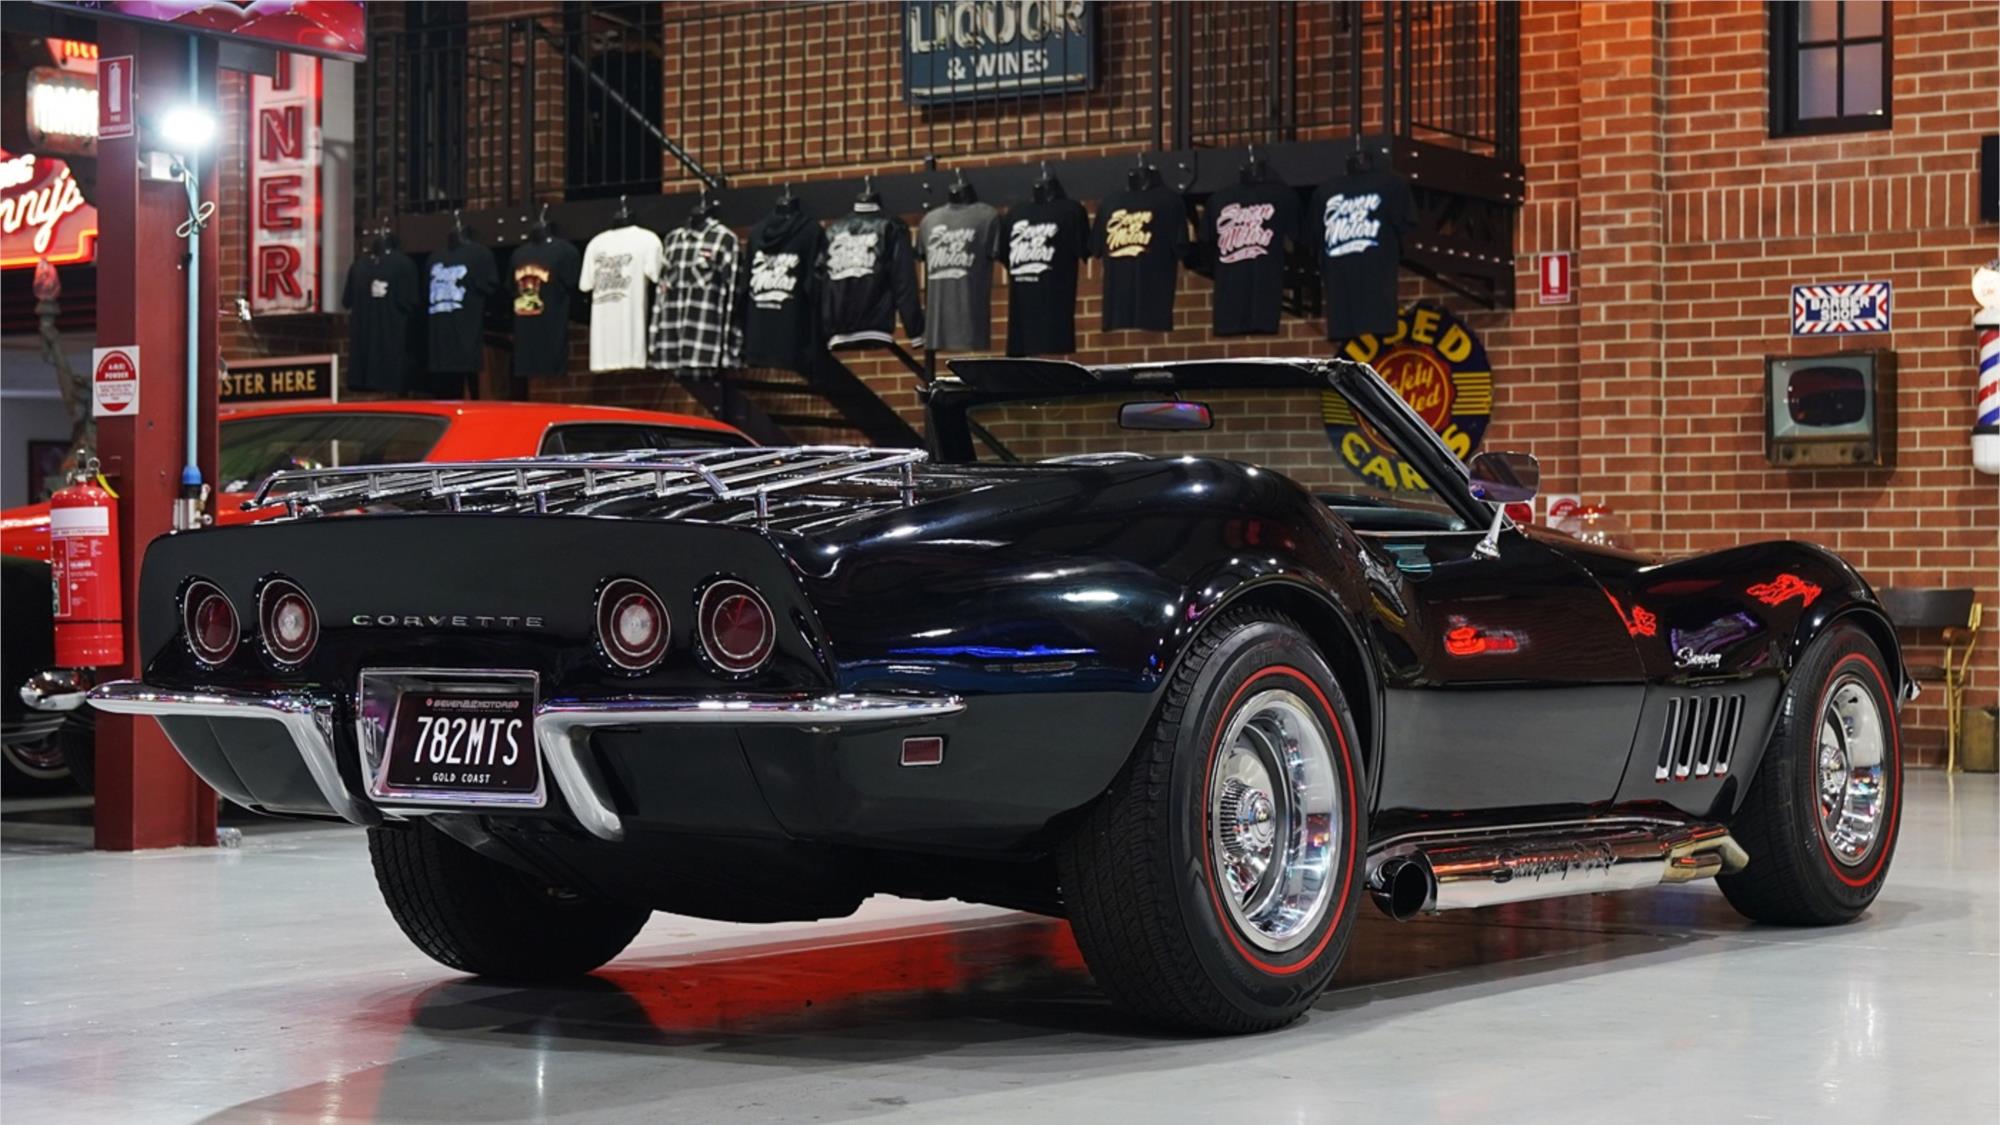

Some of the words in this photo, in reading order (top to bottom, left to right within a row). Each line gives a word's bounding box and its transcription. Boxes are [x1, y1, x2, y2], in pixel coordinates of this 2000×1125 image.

[910, 0, 1085, 53] LIQUOR
[947, 57, 966, 80] &
[971, 48, 1049, 78] WINES
[1323, 193, 1381, 226] Seven
[928, 224, 976, 251] Seven
[1009, 219, 1058, 247] Seven
[1324, 217, 1380, 248] Motors
[928, 247, 975, 272] Motors
[1009, 243, 1056, 268] Motors
[1811, 295, 1870, 311] BARBER
[1820, 306, 1861, 321] SHOP
[270, 368, 318, 393] HERE
[352, 615, 544, 628] CORVETTE
[414, 716, 523, 766] 782MTS
[432, 772, 456, 782] GOLD
[461, 774, 491, 783] COAST
